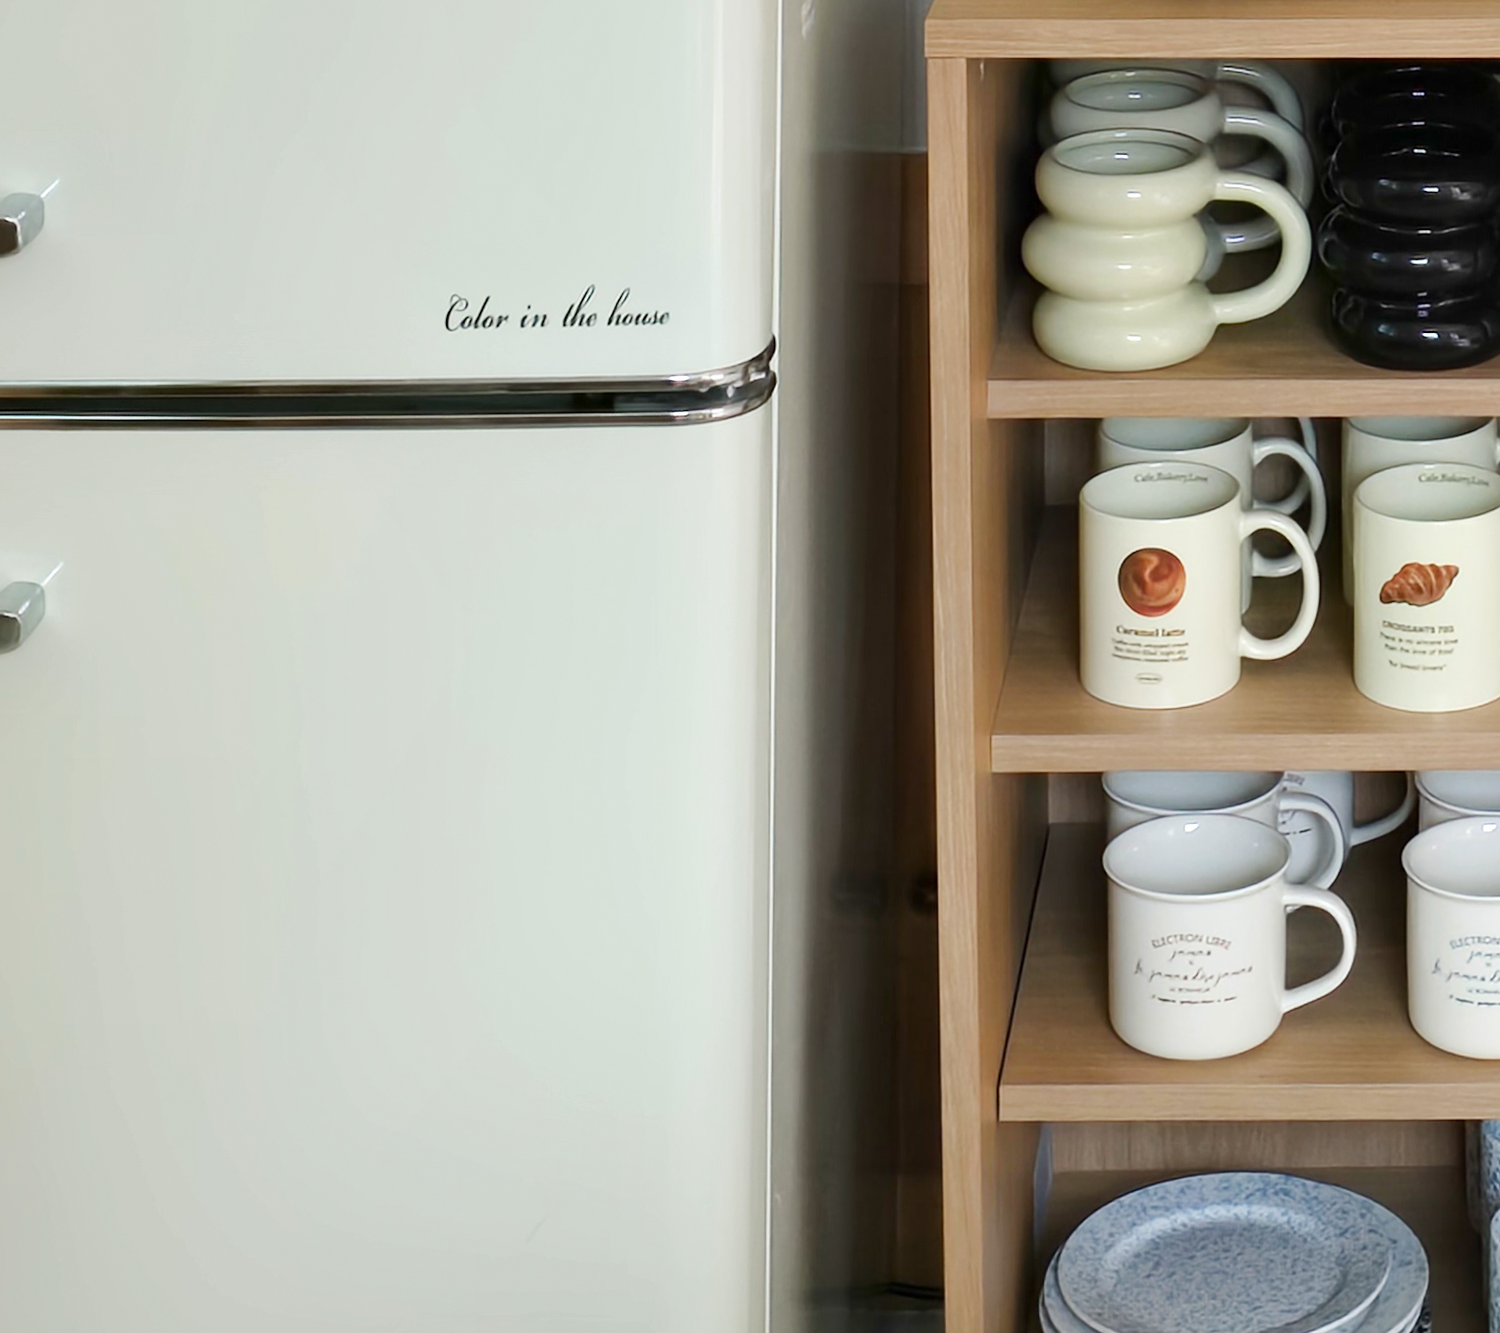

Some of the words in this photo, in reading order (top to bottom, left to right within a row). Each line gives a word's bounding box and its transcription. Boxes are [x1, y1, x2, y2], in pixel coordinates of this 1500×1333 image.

[445, 294, 509, 332] Color
[520, 305, 549, 328] in
[562, 284, 597, 328] the
[607, 288, 670, 327] house
